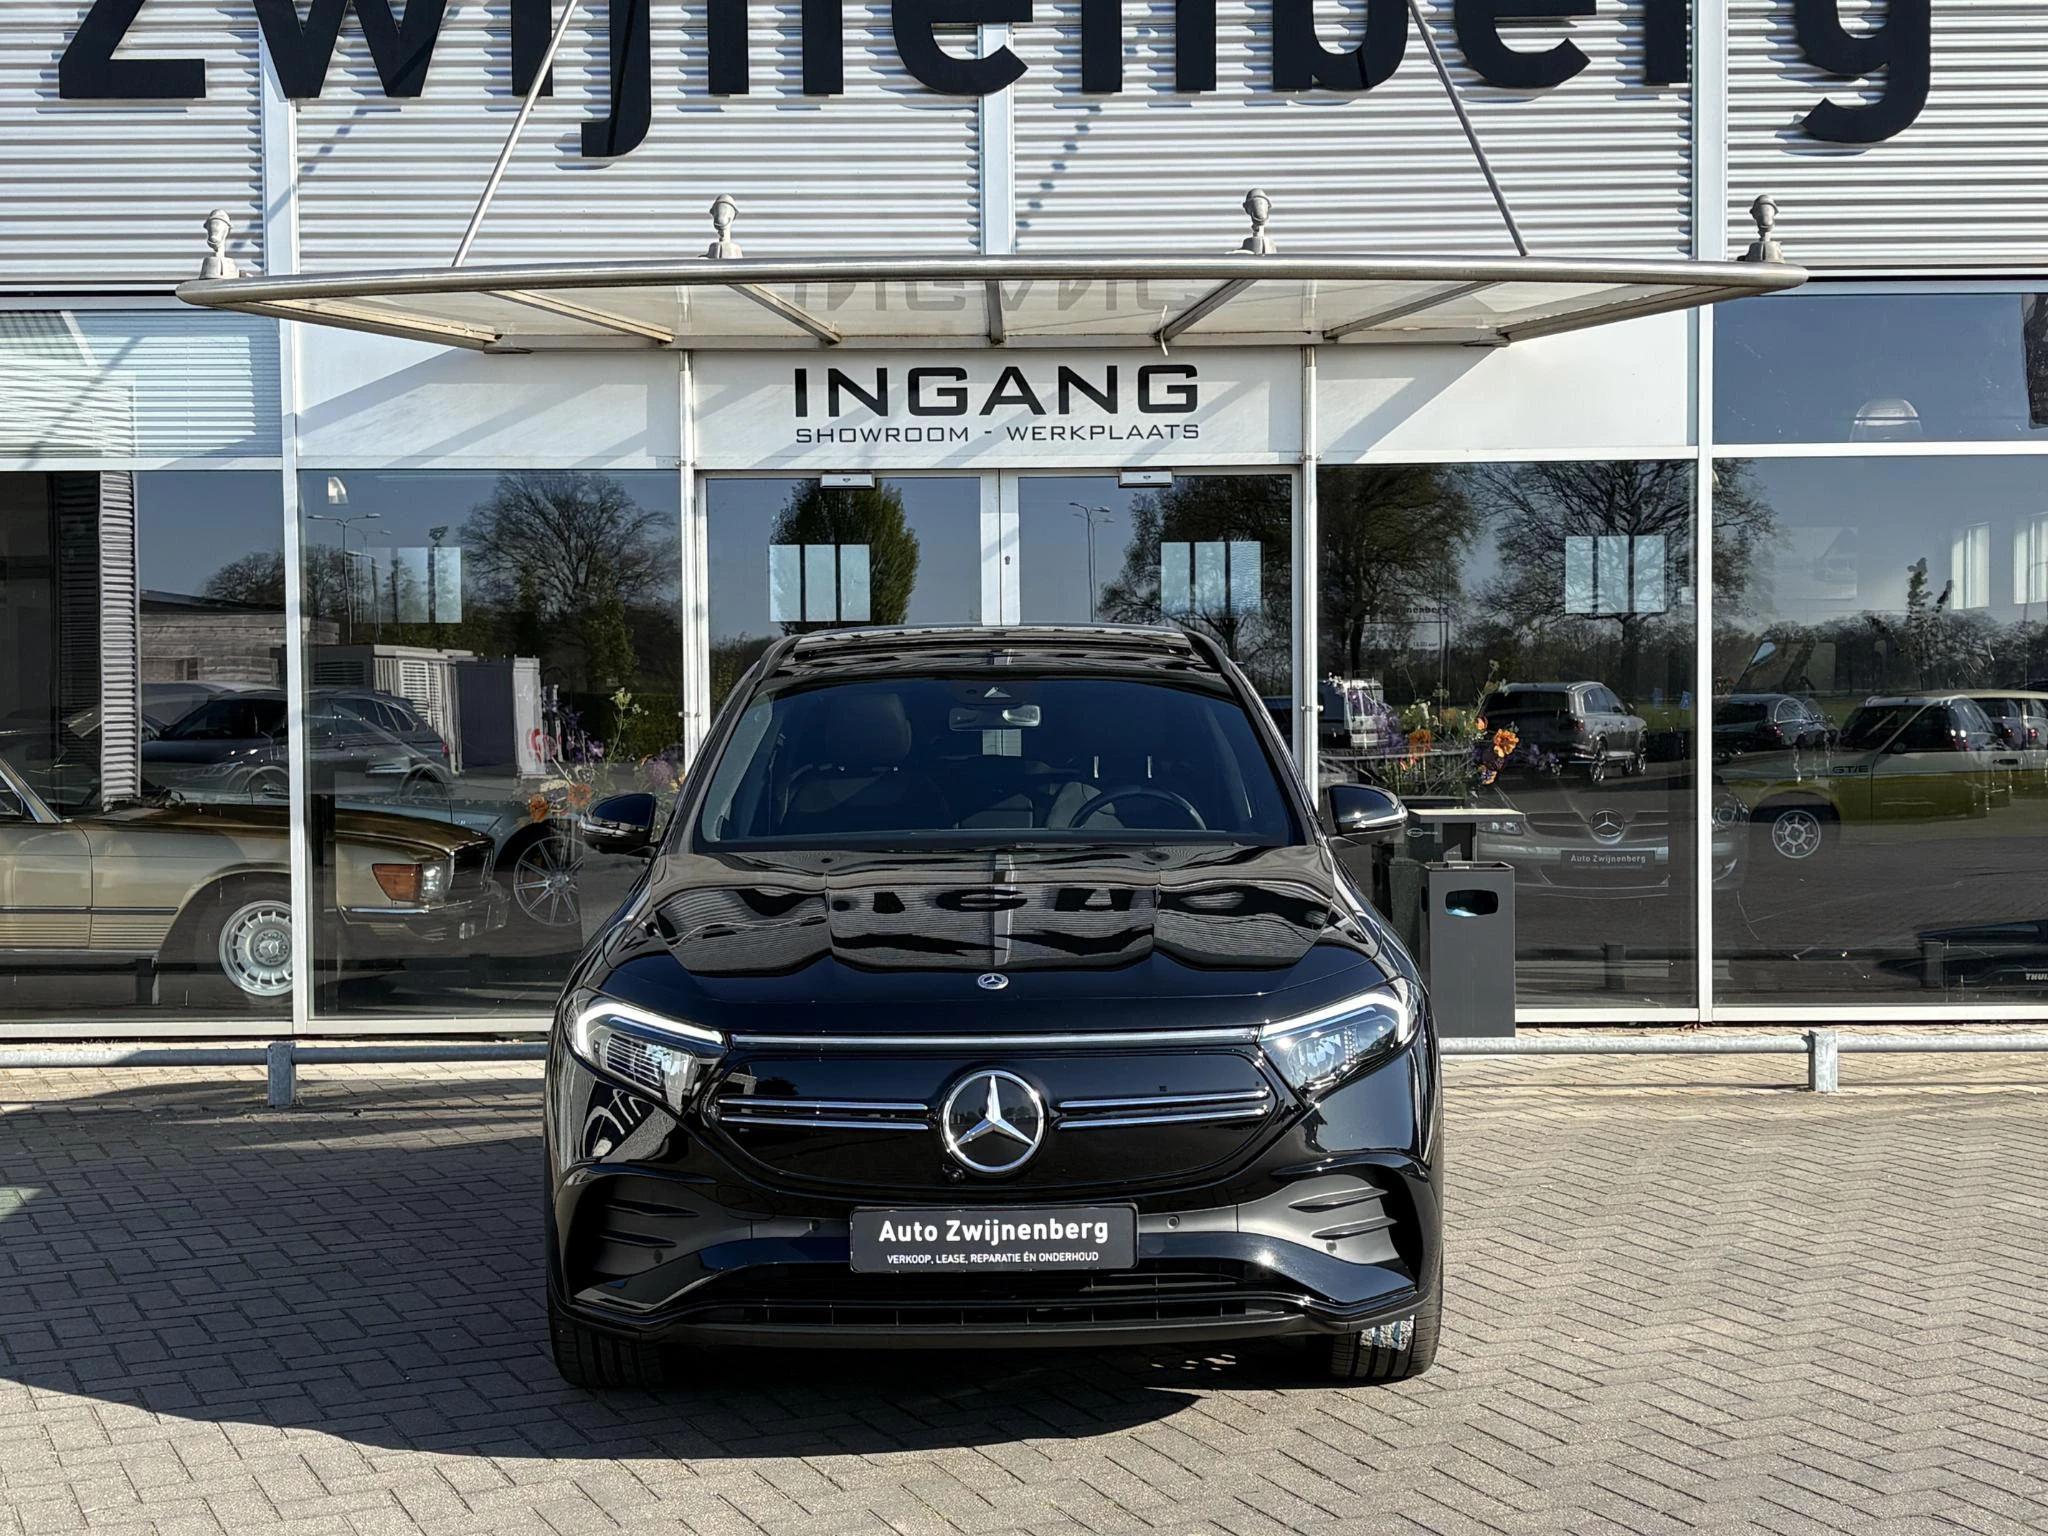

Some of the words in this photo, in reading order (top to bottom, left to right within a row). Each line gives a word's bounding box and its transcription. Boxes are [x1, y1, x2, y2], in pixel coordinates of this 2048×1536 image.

[795, 364, 1198, 418] INGANG
[796, 427, 969, 444] SHOWROOM
[1006, 424, 1199, 441] WERKPLAATS
[1570, 854, 1591, 863] Auto
[1593, 854, 1646, 863] Zwijnenberg
[878, 1220, 938, 1242] Auto
[945, 1217, 1109, 1246] Zwijnenberg
[886, 1254, 934, 1265] VERKOOP,
[936, 1254, 968, 1264] LEASE,
[970, 1253, 1021, 1264] REPARATIE
[1023, 1250, 1036, 1263] ÉN
[1038, 1251, 1099, 1263] ONDERHOUD
